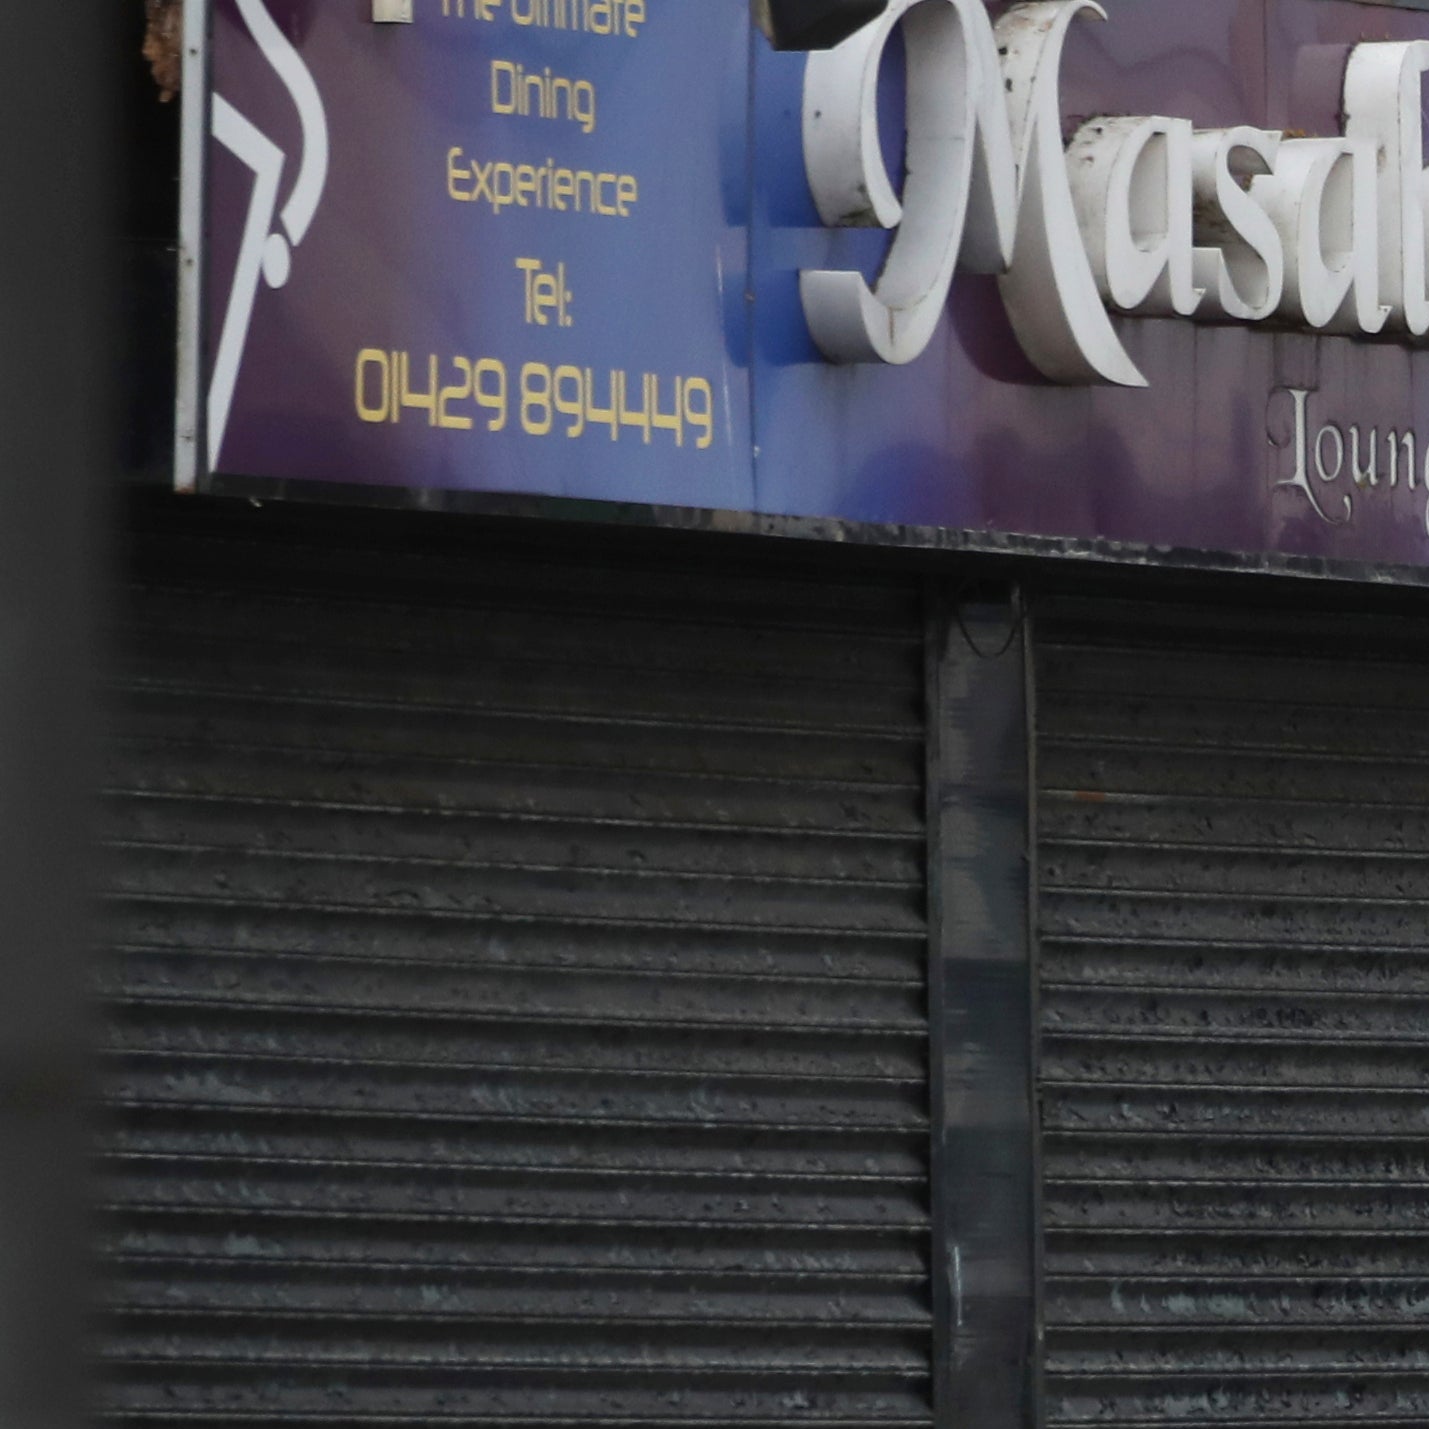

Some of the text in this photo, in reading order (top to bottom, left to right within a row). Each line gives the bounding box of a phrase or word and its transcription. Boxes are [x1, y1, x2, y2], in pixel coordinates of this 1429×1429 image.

[491, 59, 595, 133] Dining
[448, 146, 639, 217] Experience
[514, 257, 573, 328] Tel:
[355, 348, 713, 449] 01429 894449
